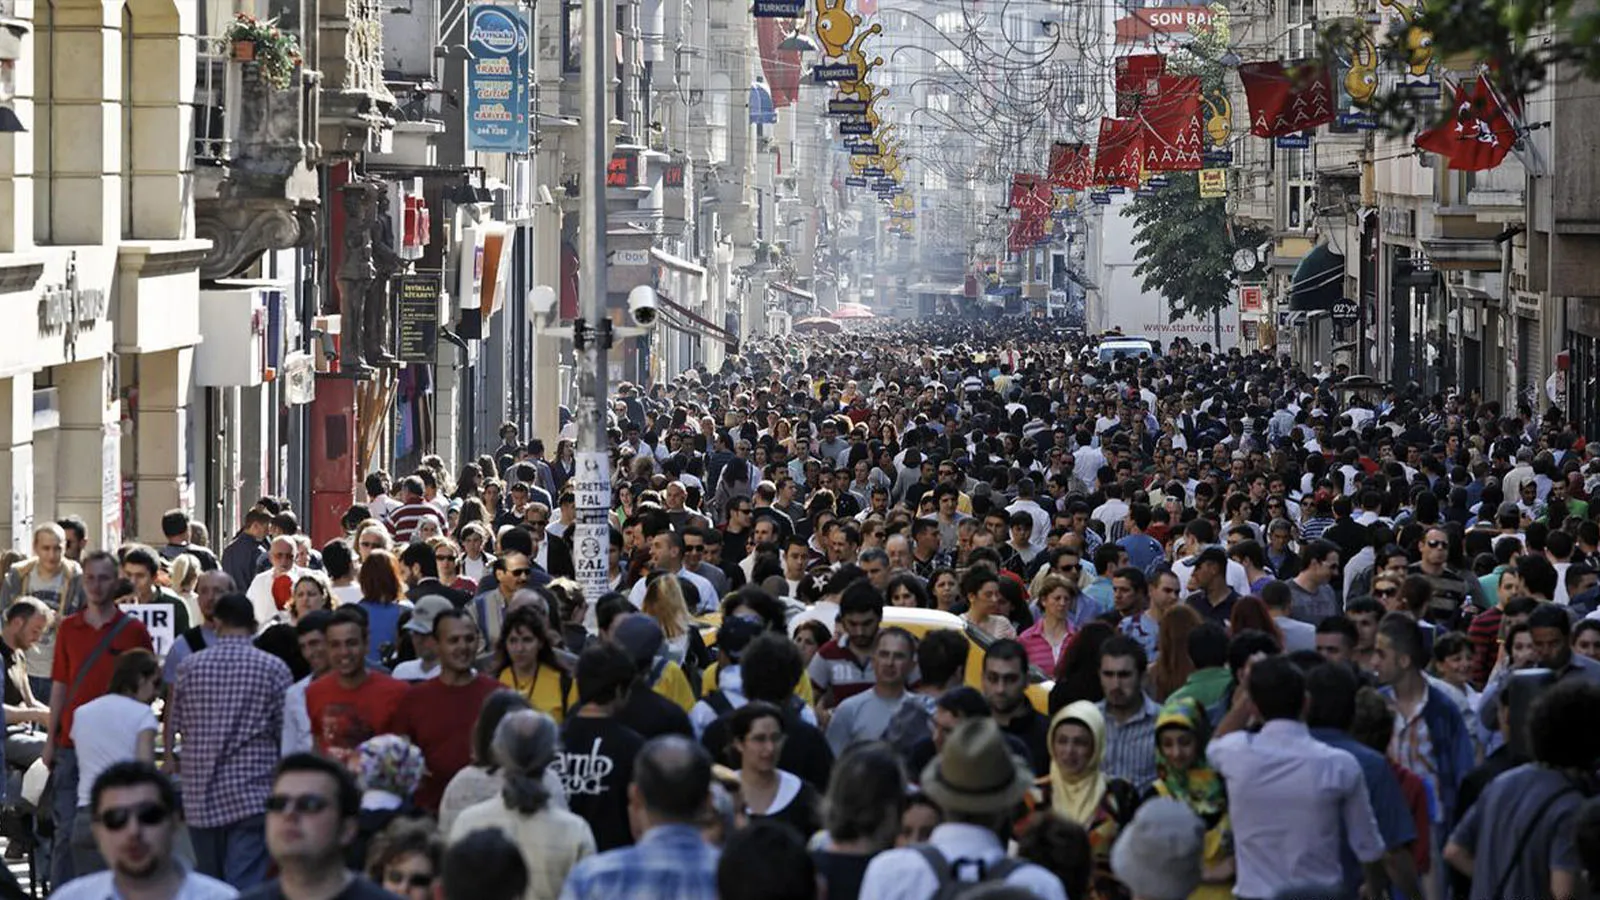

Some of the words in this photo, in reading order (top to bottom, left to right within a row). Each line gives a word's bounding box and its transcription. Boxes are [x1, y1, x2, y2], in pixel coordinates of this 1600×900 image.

[758, 3, 801, 12] TURKCELL
[1150, 12, 1182, 26] SON
[475, 63, 512, 74] TRAVEL
[818, 68, 856, 77] TURKCELL
[1246, 292, 1257, 305] E
[582, 495, 601, 505] FAL
[578, 559, 605, 570] FAL
